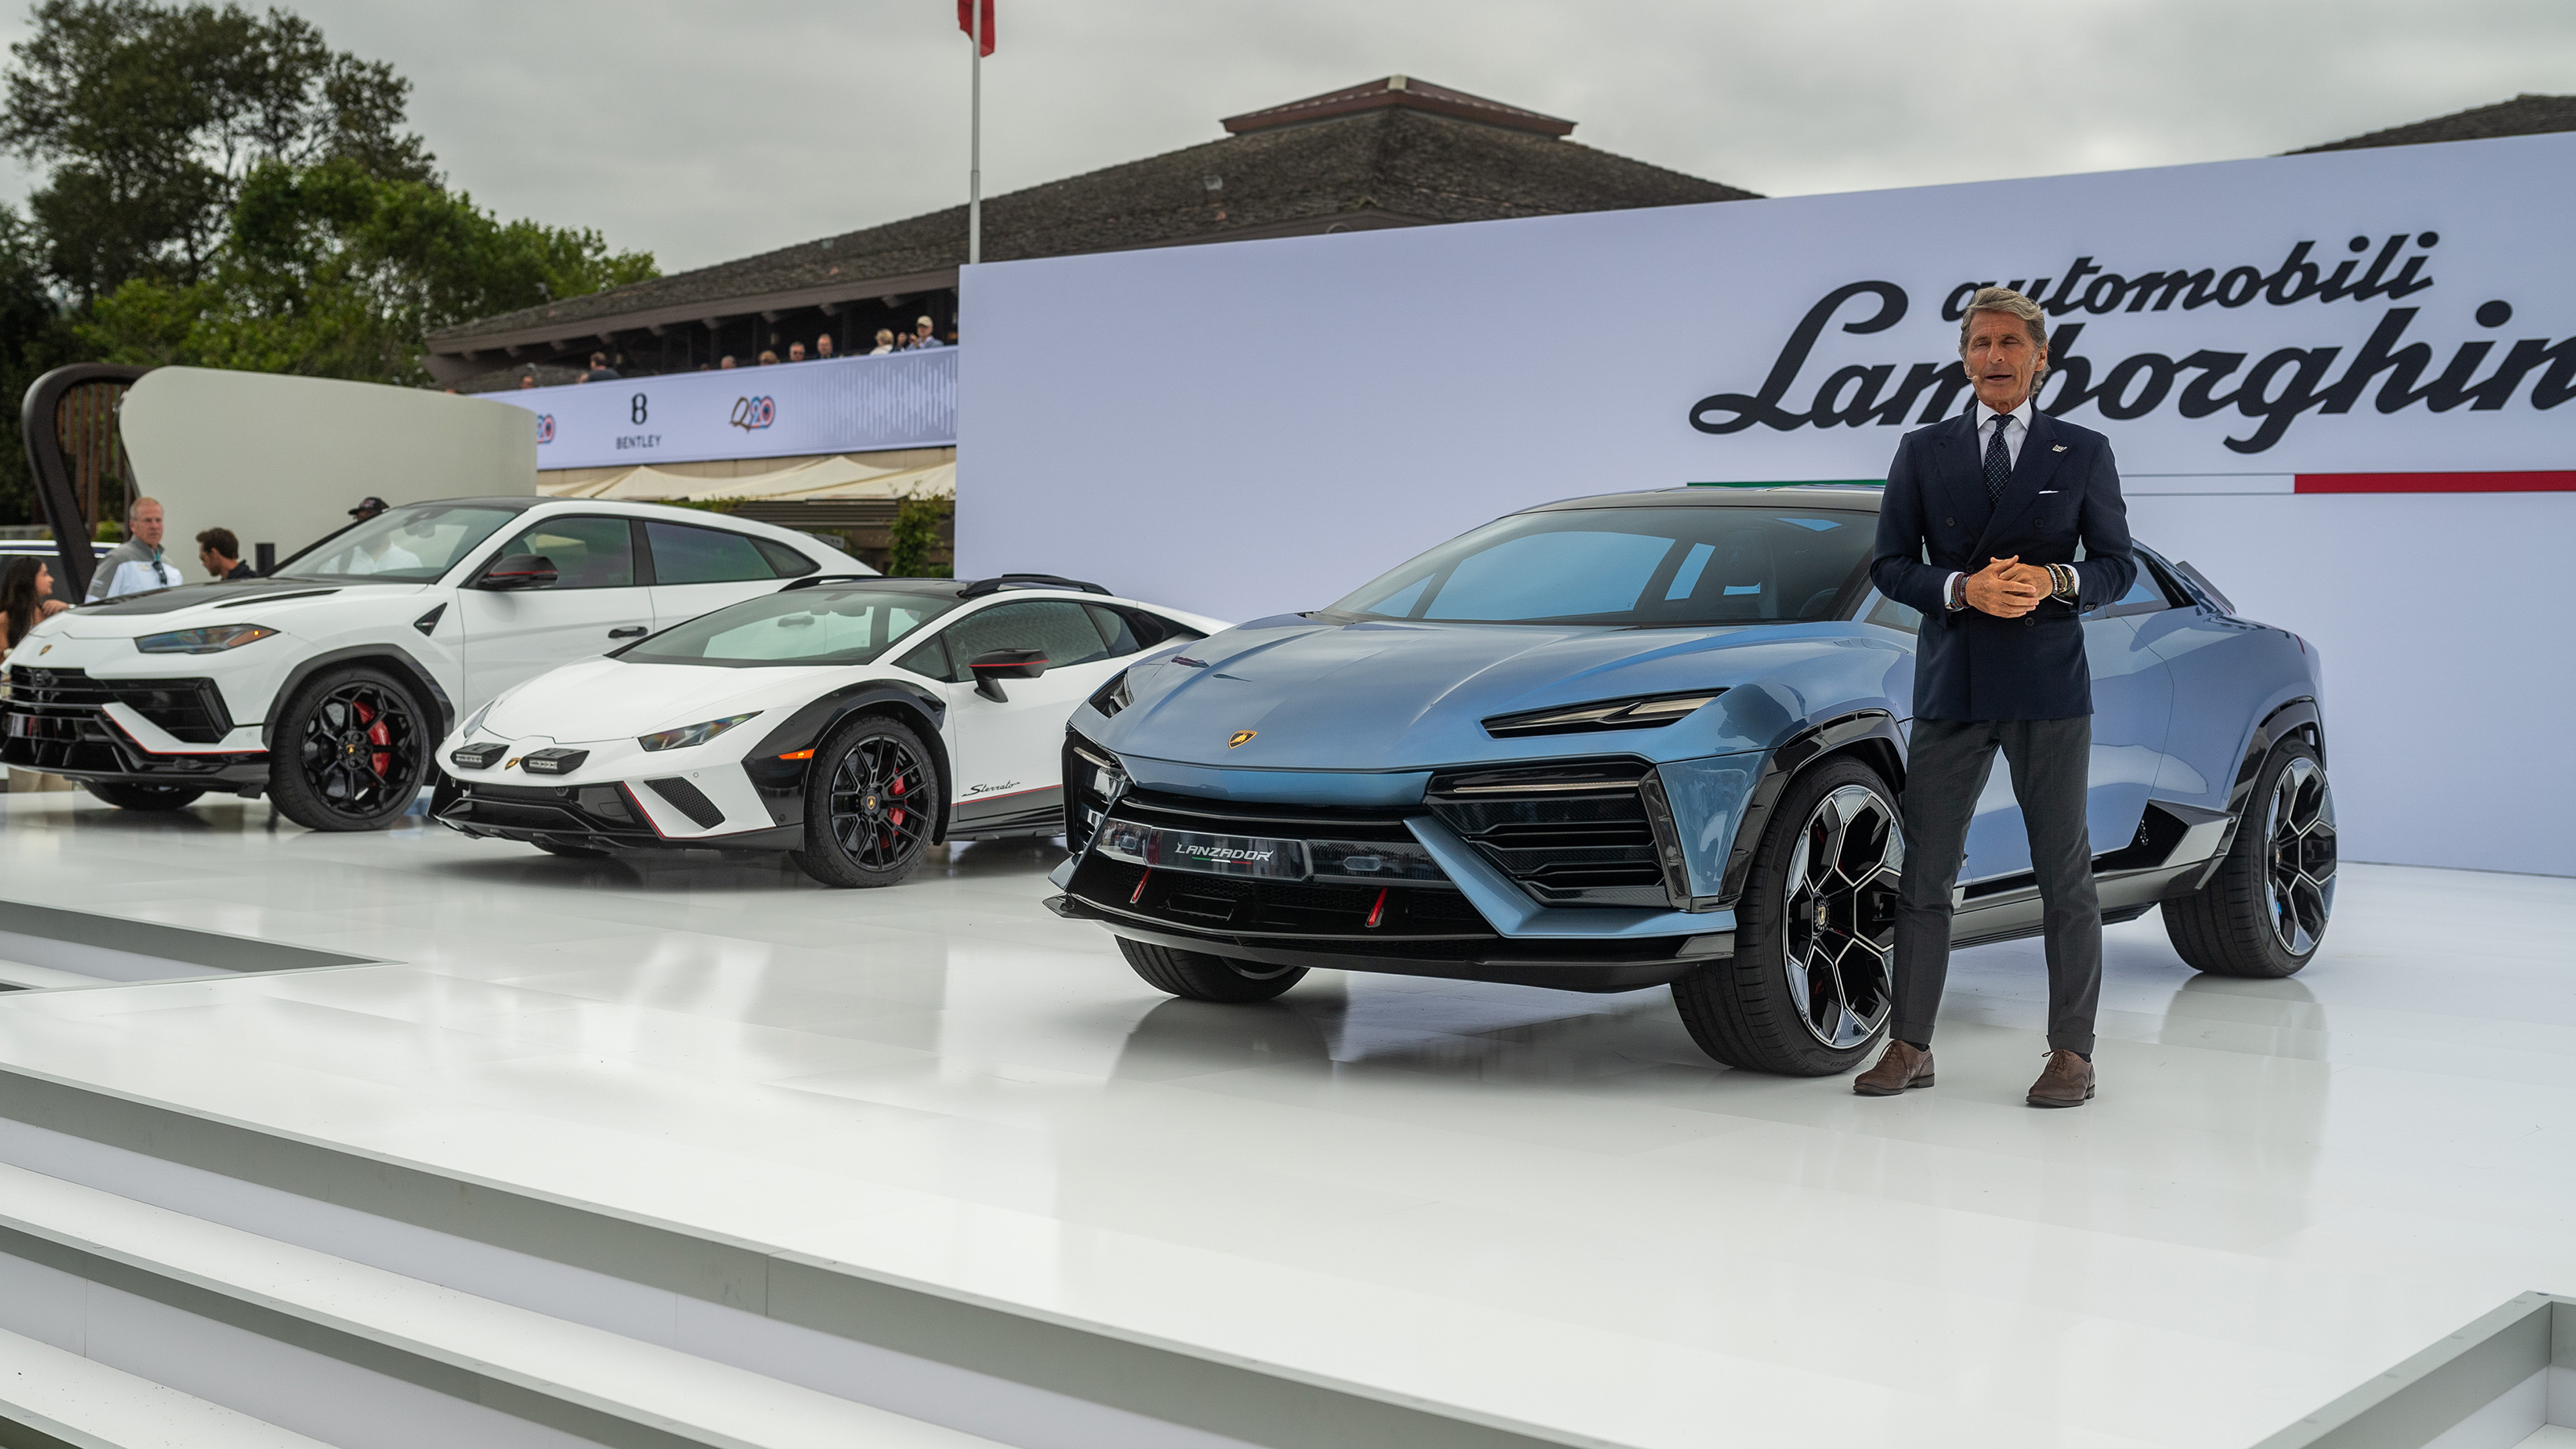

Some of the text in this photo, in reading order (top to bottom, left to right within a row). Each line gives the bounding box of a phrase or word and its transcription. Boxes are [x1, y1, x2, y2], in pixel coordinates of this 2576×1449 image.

[1942, 229, 2441, 322] automobili
[616, 434, 663, 450] BENTLEY
[961, 779, 1021, 798] Sterrato
[1174, 841, 1274, 862] LANZADOR
